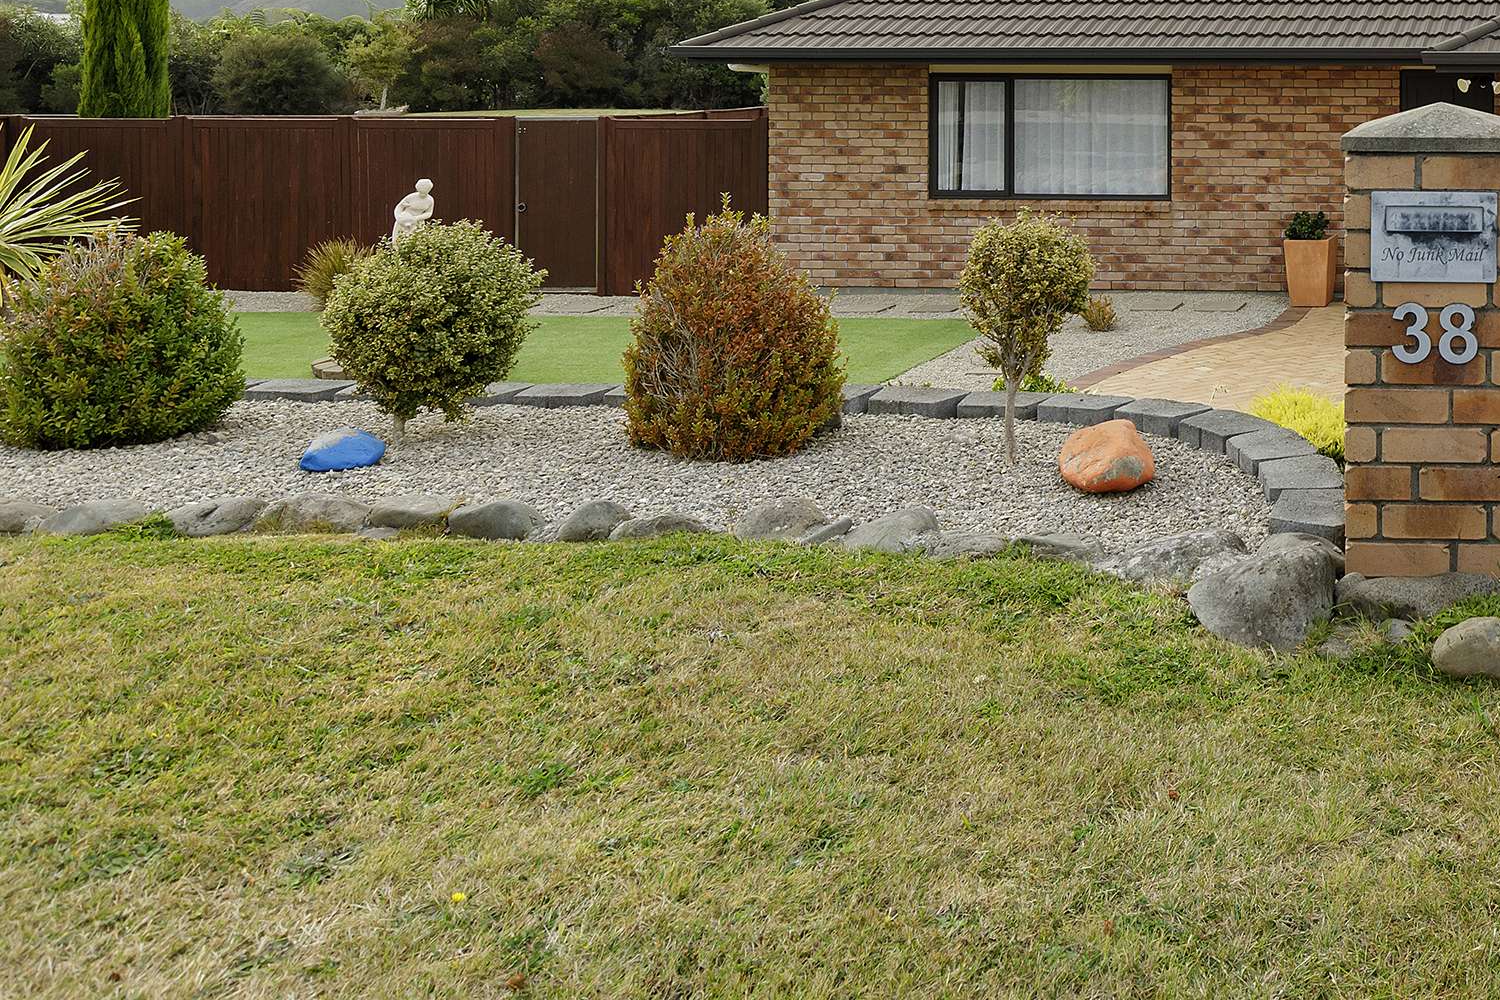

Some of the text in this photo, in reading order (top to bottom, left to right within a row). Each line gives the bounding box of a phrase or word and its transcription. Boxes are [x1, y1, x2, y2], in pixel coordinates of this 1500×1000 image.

[1381, 247, 1485, 265] No Junk Mail
[1392, 302, 1478, 365] 38
